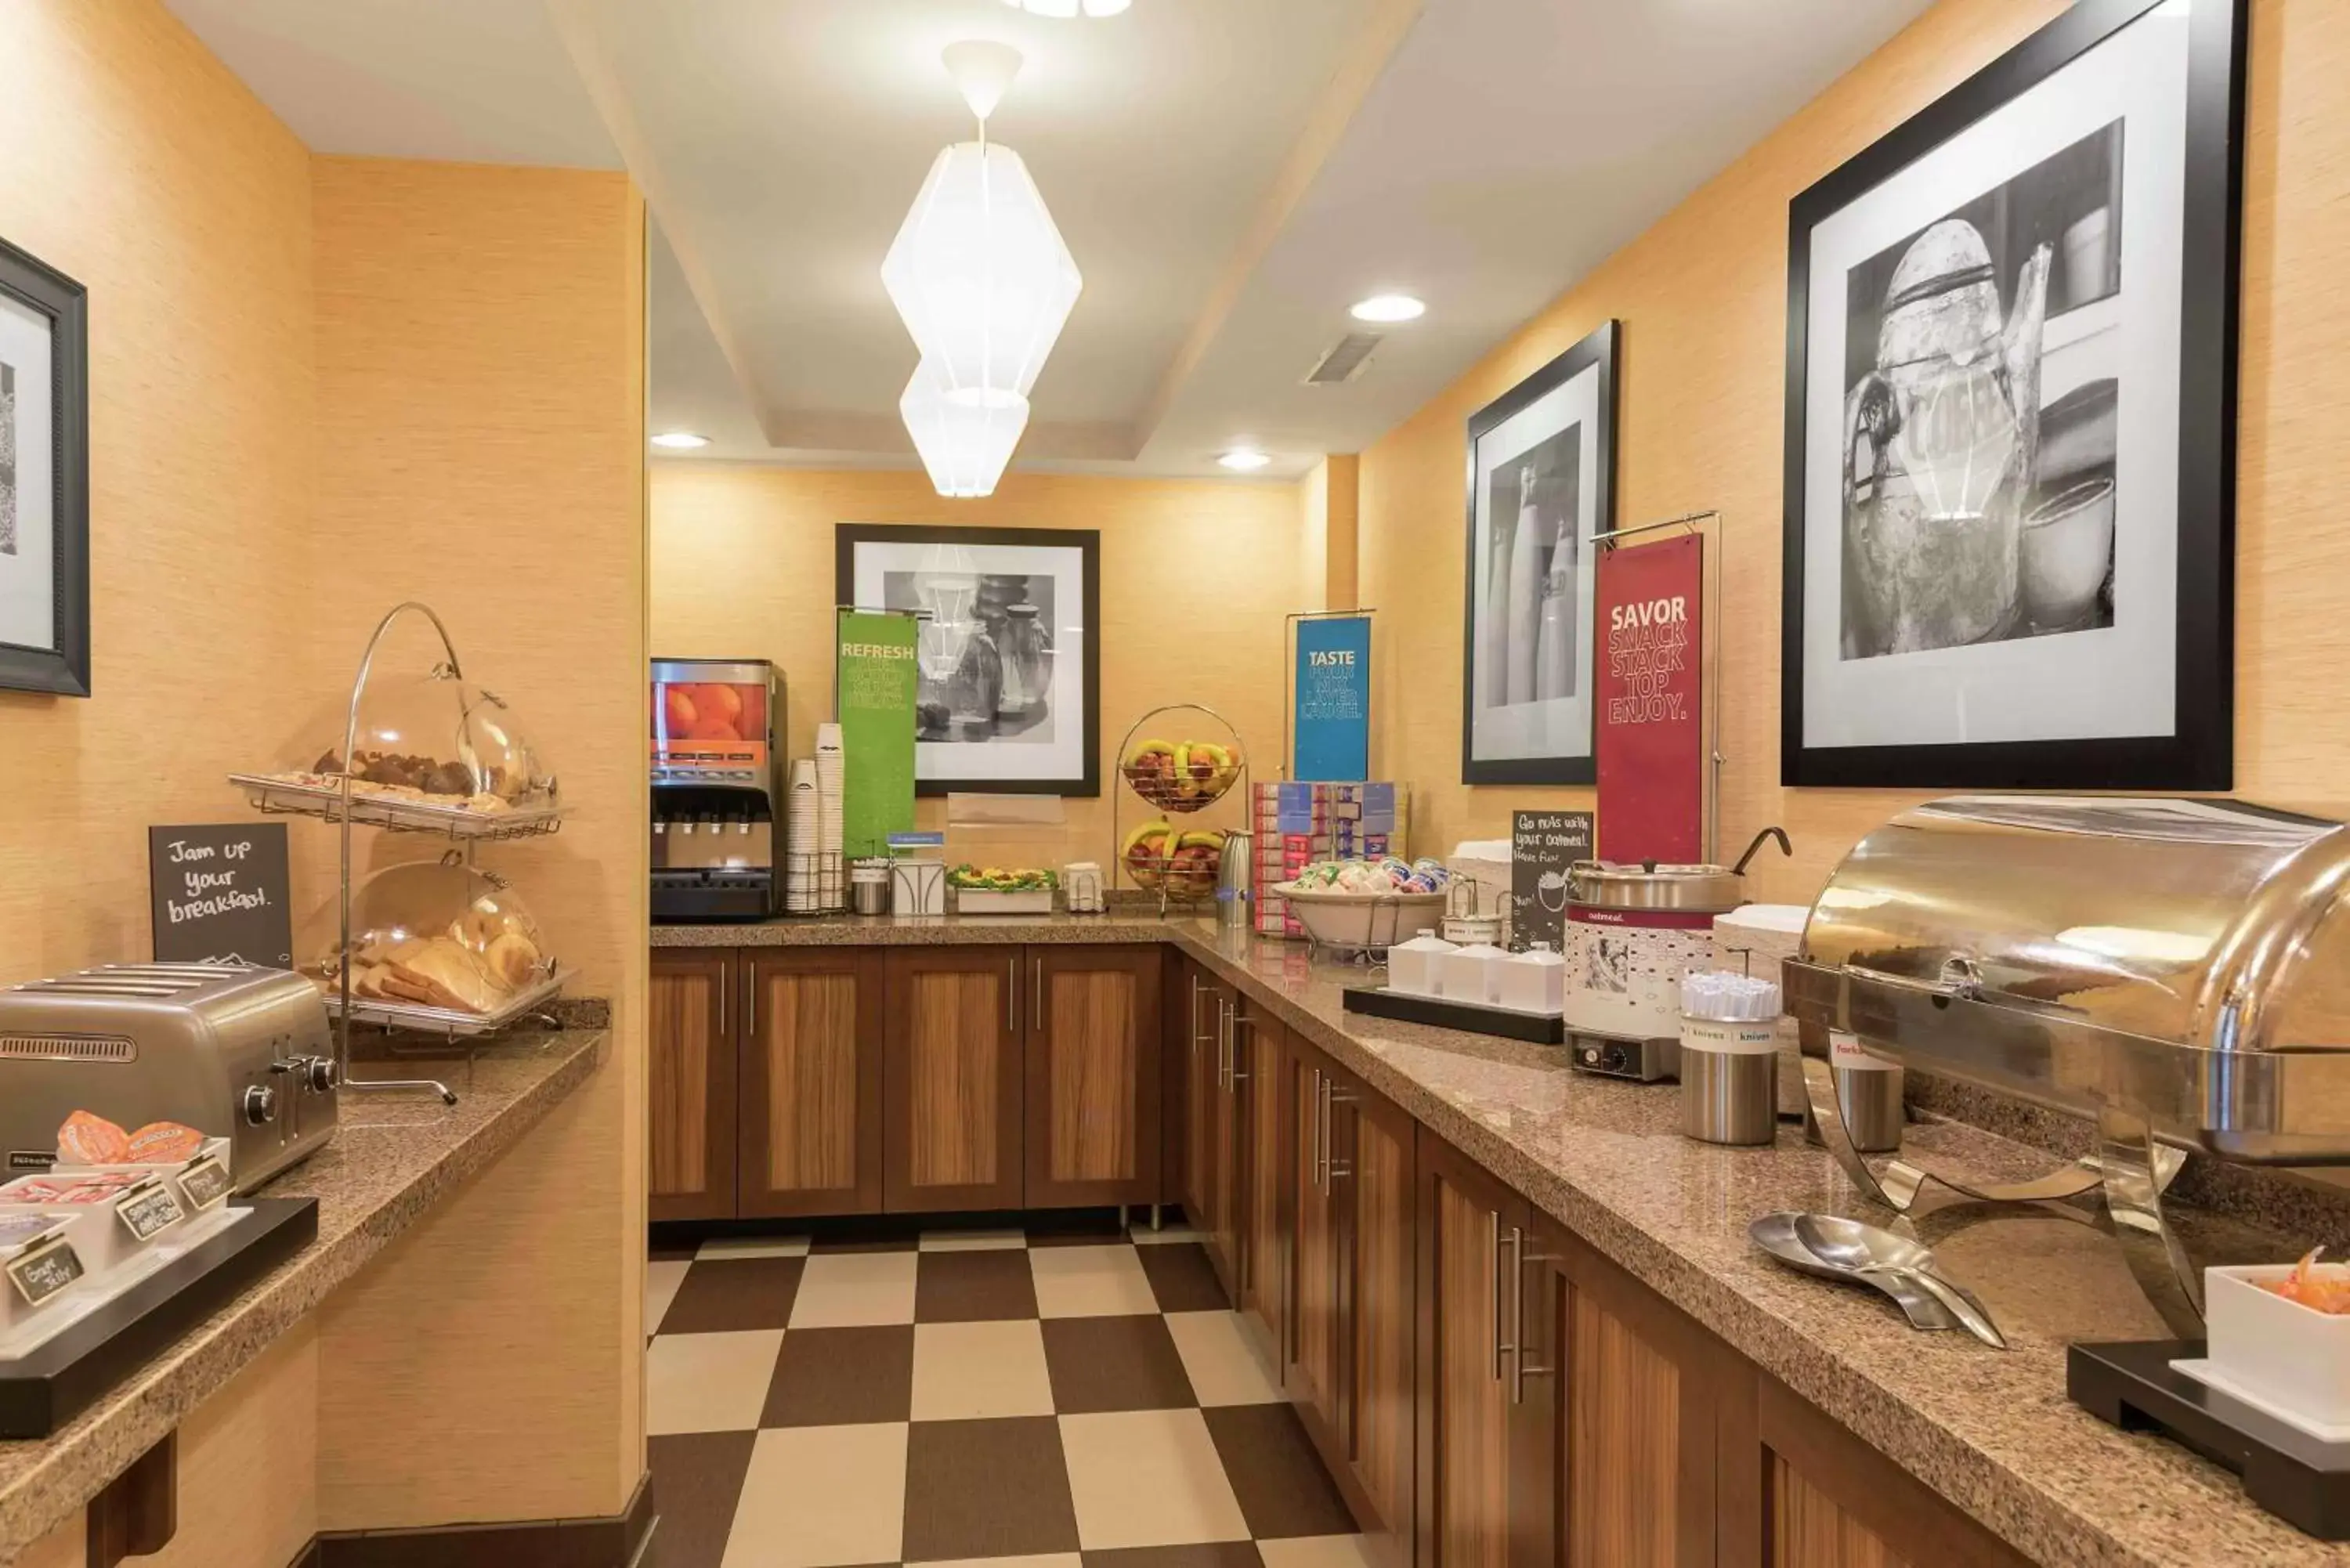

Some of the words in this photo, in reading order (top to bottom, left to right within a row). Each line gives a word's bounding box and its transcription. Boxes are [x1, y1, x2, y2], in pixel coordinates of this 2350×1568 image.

[1611, 596, 1686, 630] SAVOR
[1609, 618, 1687, 653] SNACK
[842, 642, 914, 659] REFRESH
[1309, 651, 1354, 666] TASTE
[1611, 644, 1685, 677] STACK
[1625, 670, 1668, 698] TOP
[1608, 693, 1687, 724] ENJOY.
[1519, 814, 1535, 830] Go
[1538, 815, 1561, 830] nuts
[1564, 815, 1588, 831] with
[167, 840, 215, 862] Jam
[1516, 833, 1542, 849] your
[185, 871, 236, 897] your
[167, 887, 272, 923] breakfast.
[1740, 1031, 1770, 1041] knives
